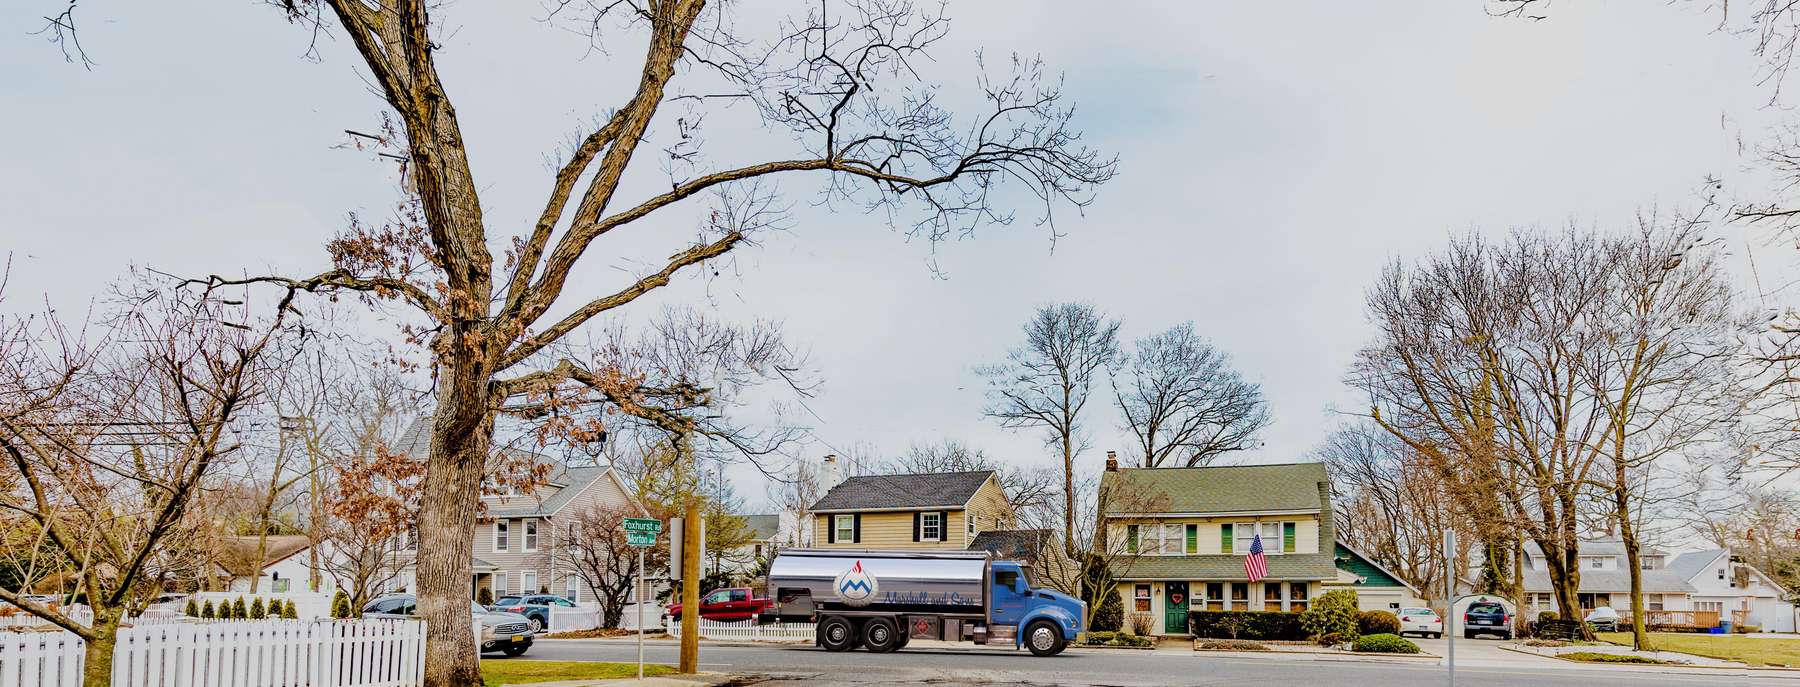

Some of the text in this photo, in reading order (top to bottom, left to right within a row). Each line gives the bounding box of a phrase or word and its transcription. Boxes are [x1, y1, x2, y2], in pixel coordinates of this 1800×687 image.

[624, 520, 653, 530] Foxhurst
[628, 534, 648, 543] Morton
[930, 591, 948, 604] and
